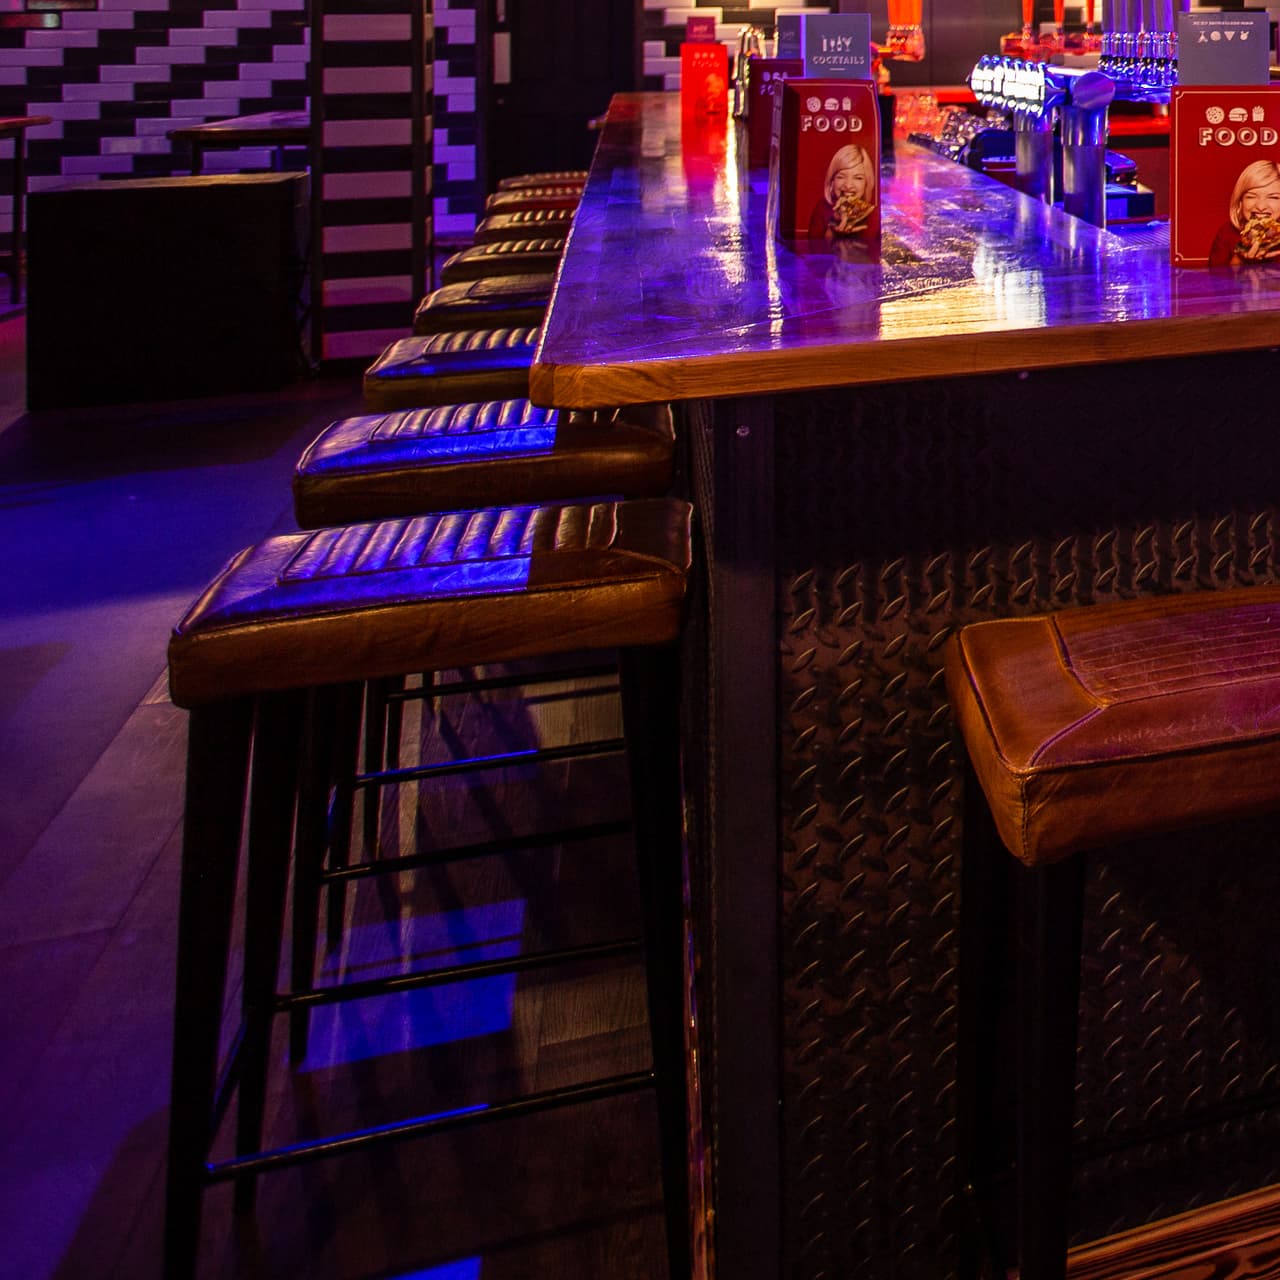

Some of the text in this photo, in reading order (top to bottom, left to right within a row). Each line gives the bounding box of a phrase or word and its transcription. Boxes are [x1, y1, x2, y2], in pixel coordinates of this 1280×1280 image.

[812, 55, 865, 65] COCKTAILS
[801, 115, 863, 132] FOOD
[1198, 126, 1279, 147] FOOD
